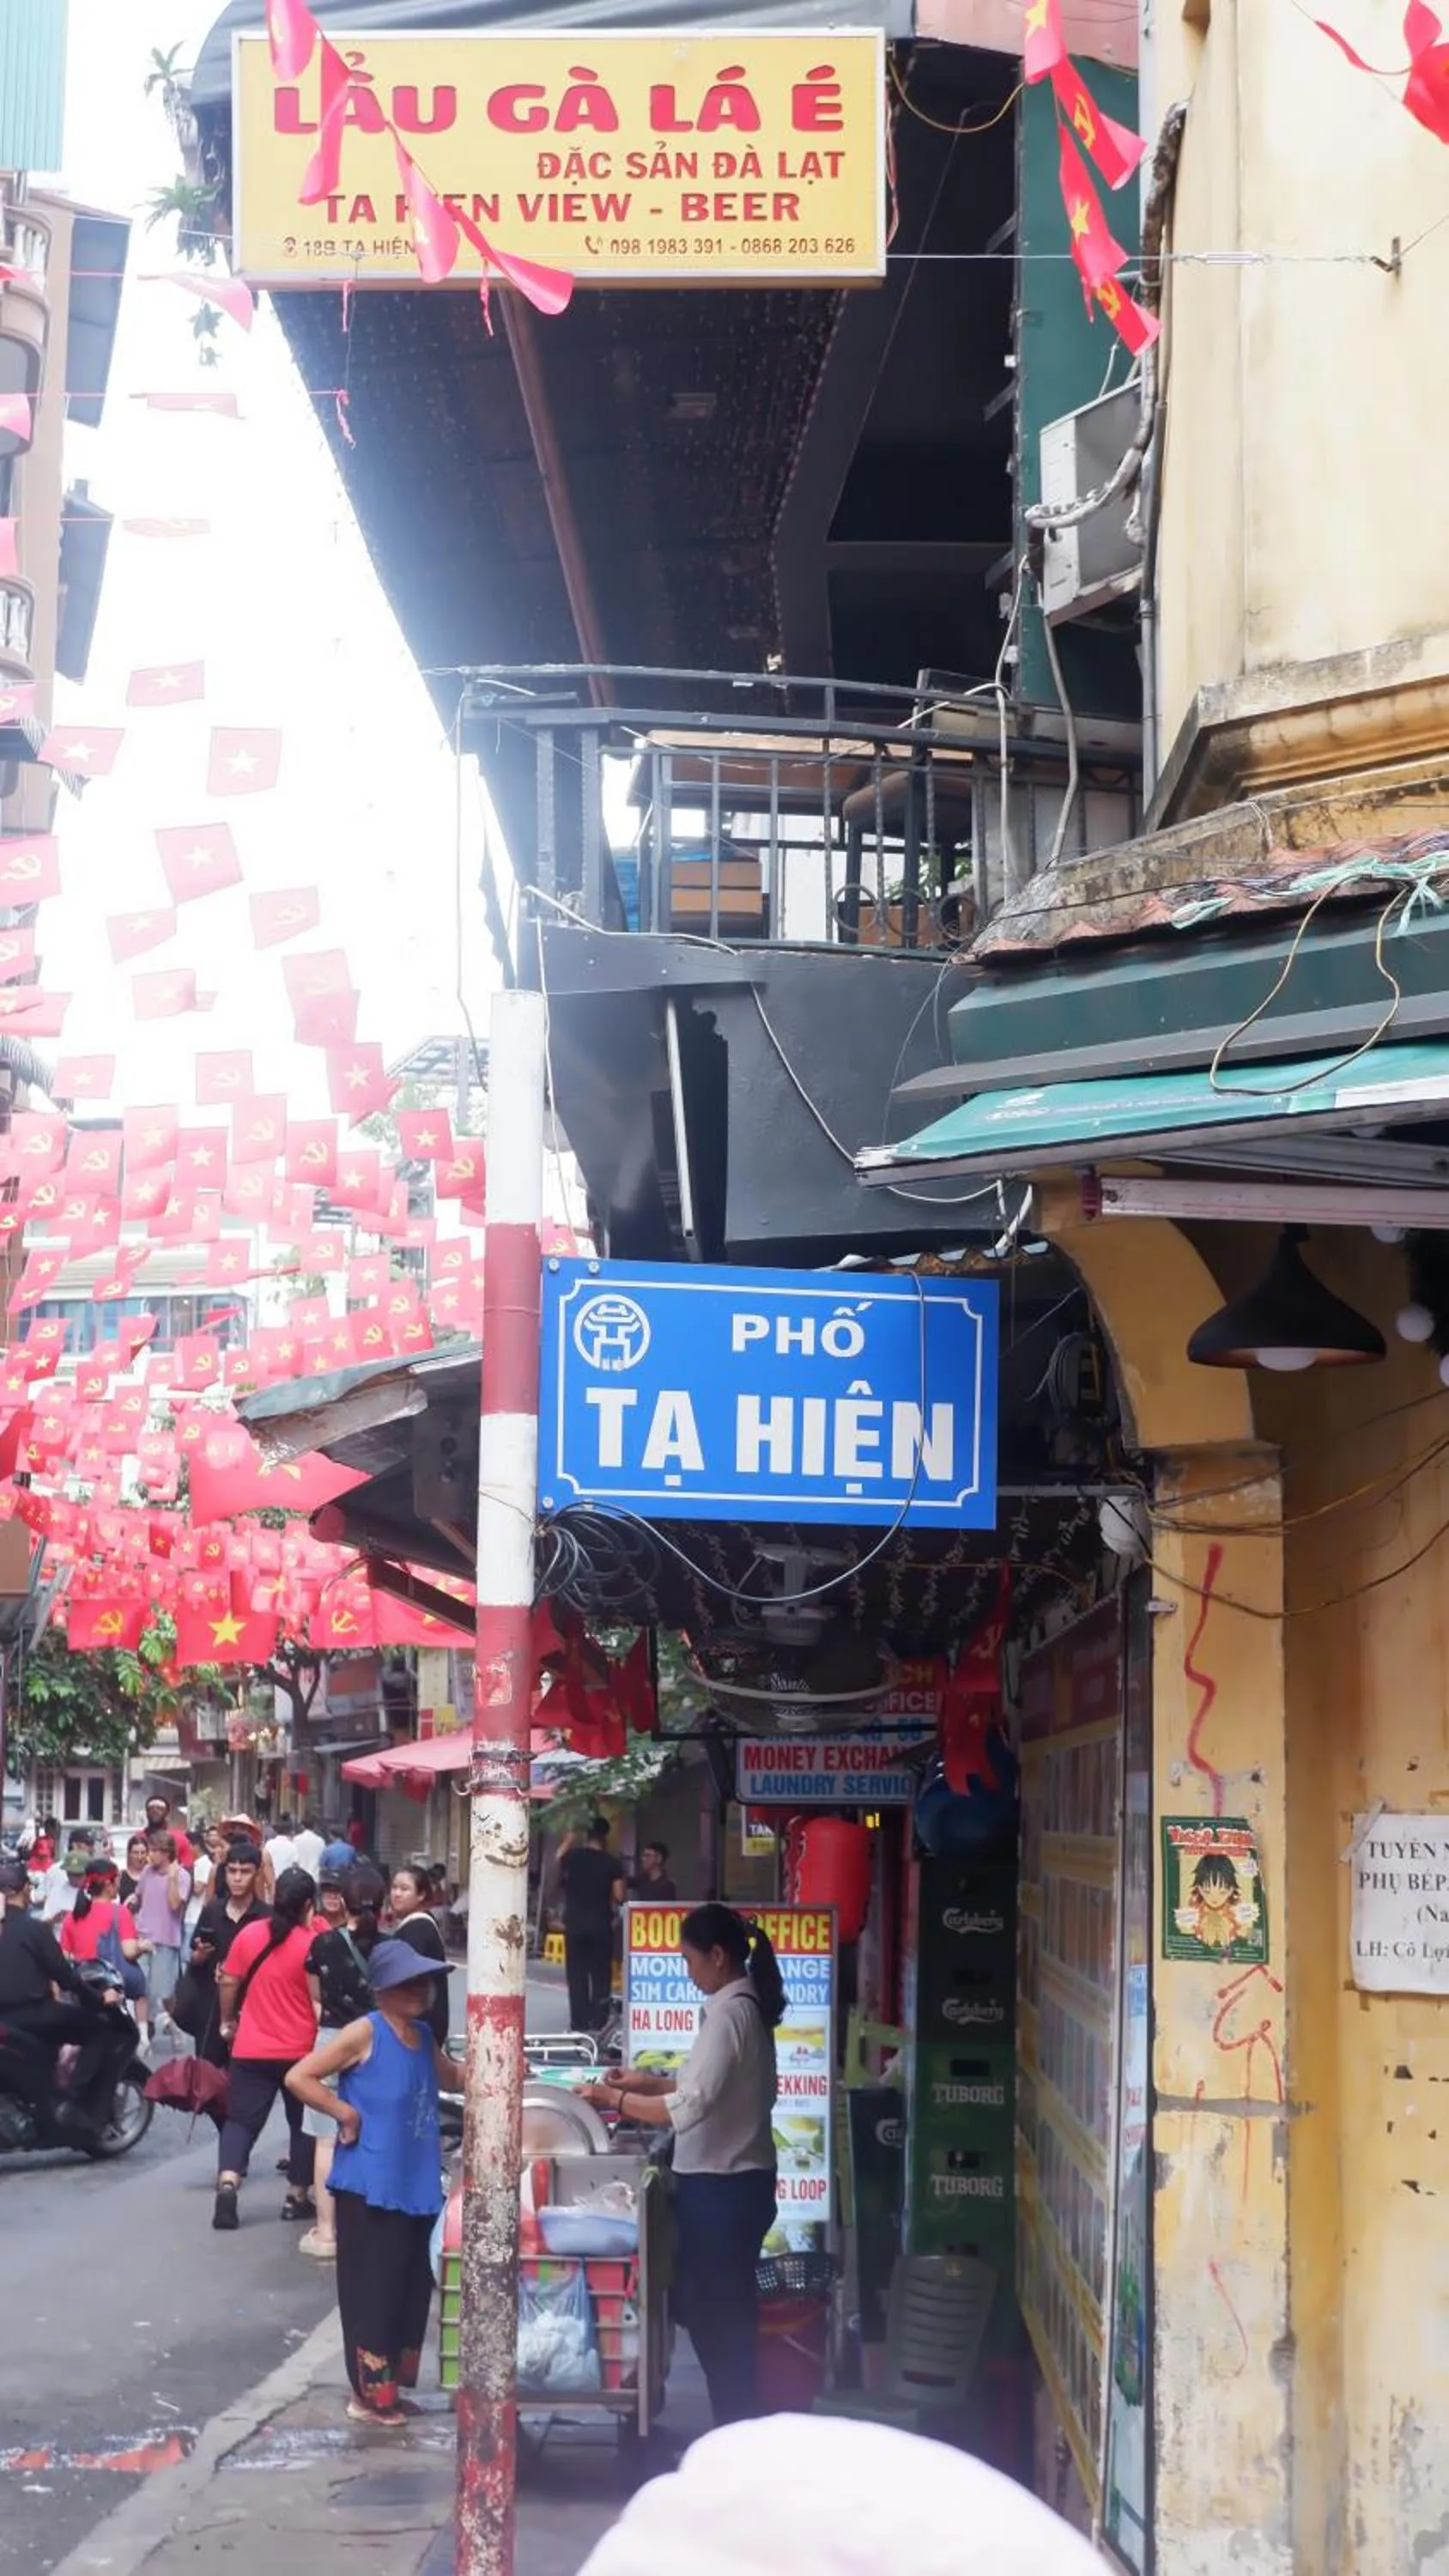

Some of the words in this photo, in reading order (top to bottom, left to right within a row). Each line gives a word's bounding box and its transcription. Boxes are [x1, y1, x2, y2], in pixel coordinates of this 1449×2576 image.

[487, 65, 619, 134] GÀ
[650, 65, 761, 132] LÁ
[791, 64, 844, 132] É
[537, 146, 611, 186] ĐẶC
[626, 141, 698, 179] SẢN
[712, 144, 763, 179] ĐÀ
[778, 150, 846, 185] LẠT
[517, 193, 632, 222] VIEW
[681, 192, 800, 222] BEER
[610, 239, 641, 255] 098
[648, 238, 688, 255] 1983
[694, 237, 723, 255] 391
[742, 237, 782, 255] 0868
[789, 237, 823, 255] 203
[825, 237, 855, 254] 626
[731, 1301, 873, 1358] PHỐ
[585, 1388, 705, 1486] TẠ
[736, 1380, 954, 1495] HIỆN
[744, 1745, 815, 1771] MONEY
[751, 1774, 835, 1795] LAUNDRY
[843, 1774, 910, 1795] SERVIC
[1359, 1871, 1401, 1894] PHỤ
[943, 1908, 1004, 1934] Carlsberg
[1416, 1904, 1449, 1923] (Na
[631, 1911, 684, 1948] BOO
[1356, 1941, 1388, 1957] LH:
[631, 1957, 689, 1977] MON
[631, 1981, 662, 2002] SIM
[783, 1983, 829, 2003] NDRY
[632, 2009, 651, 2031] HA
[656, 2009, 694, 2031] LONG
[943, 1998, 1004, 2025] Carlsberg
[775, 2074, 827, 2096] EKKING
[932, 2084, 1004, 2105] TUBORG
[791, 2178, 827, 2200] LOOP
[931, 2174, 1003, 2196] TUBORG
